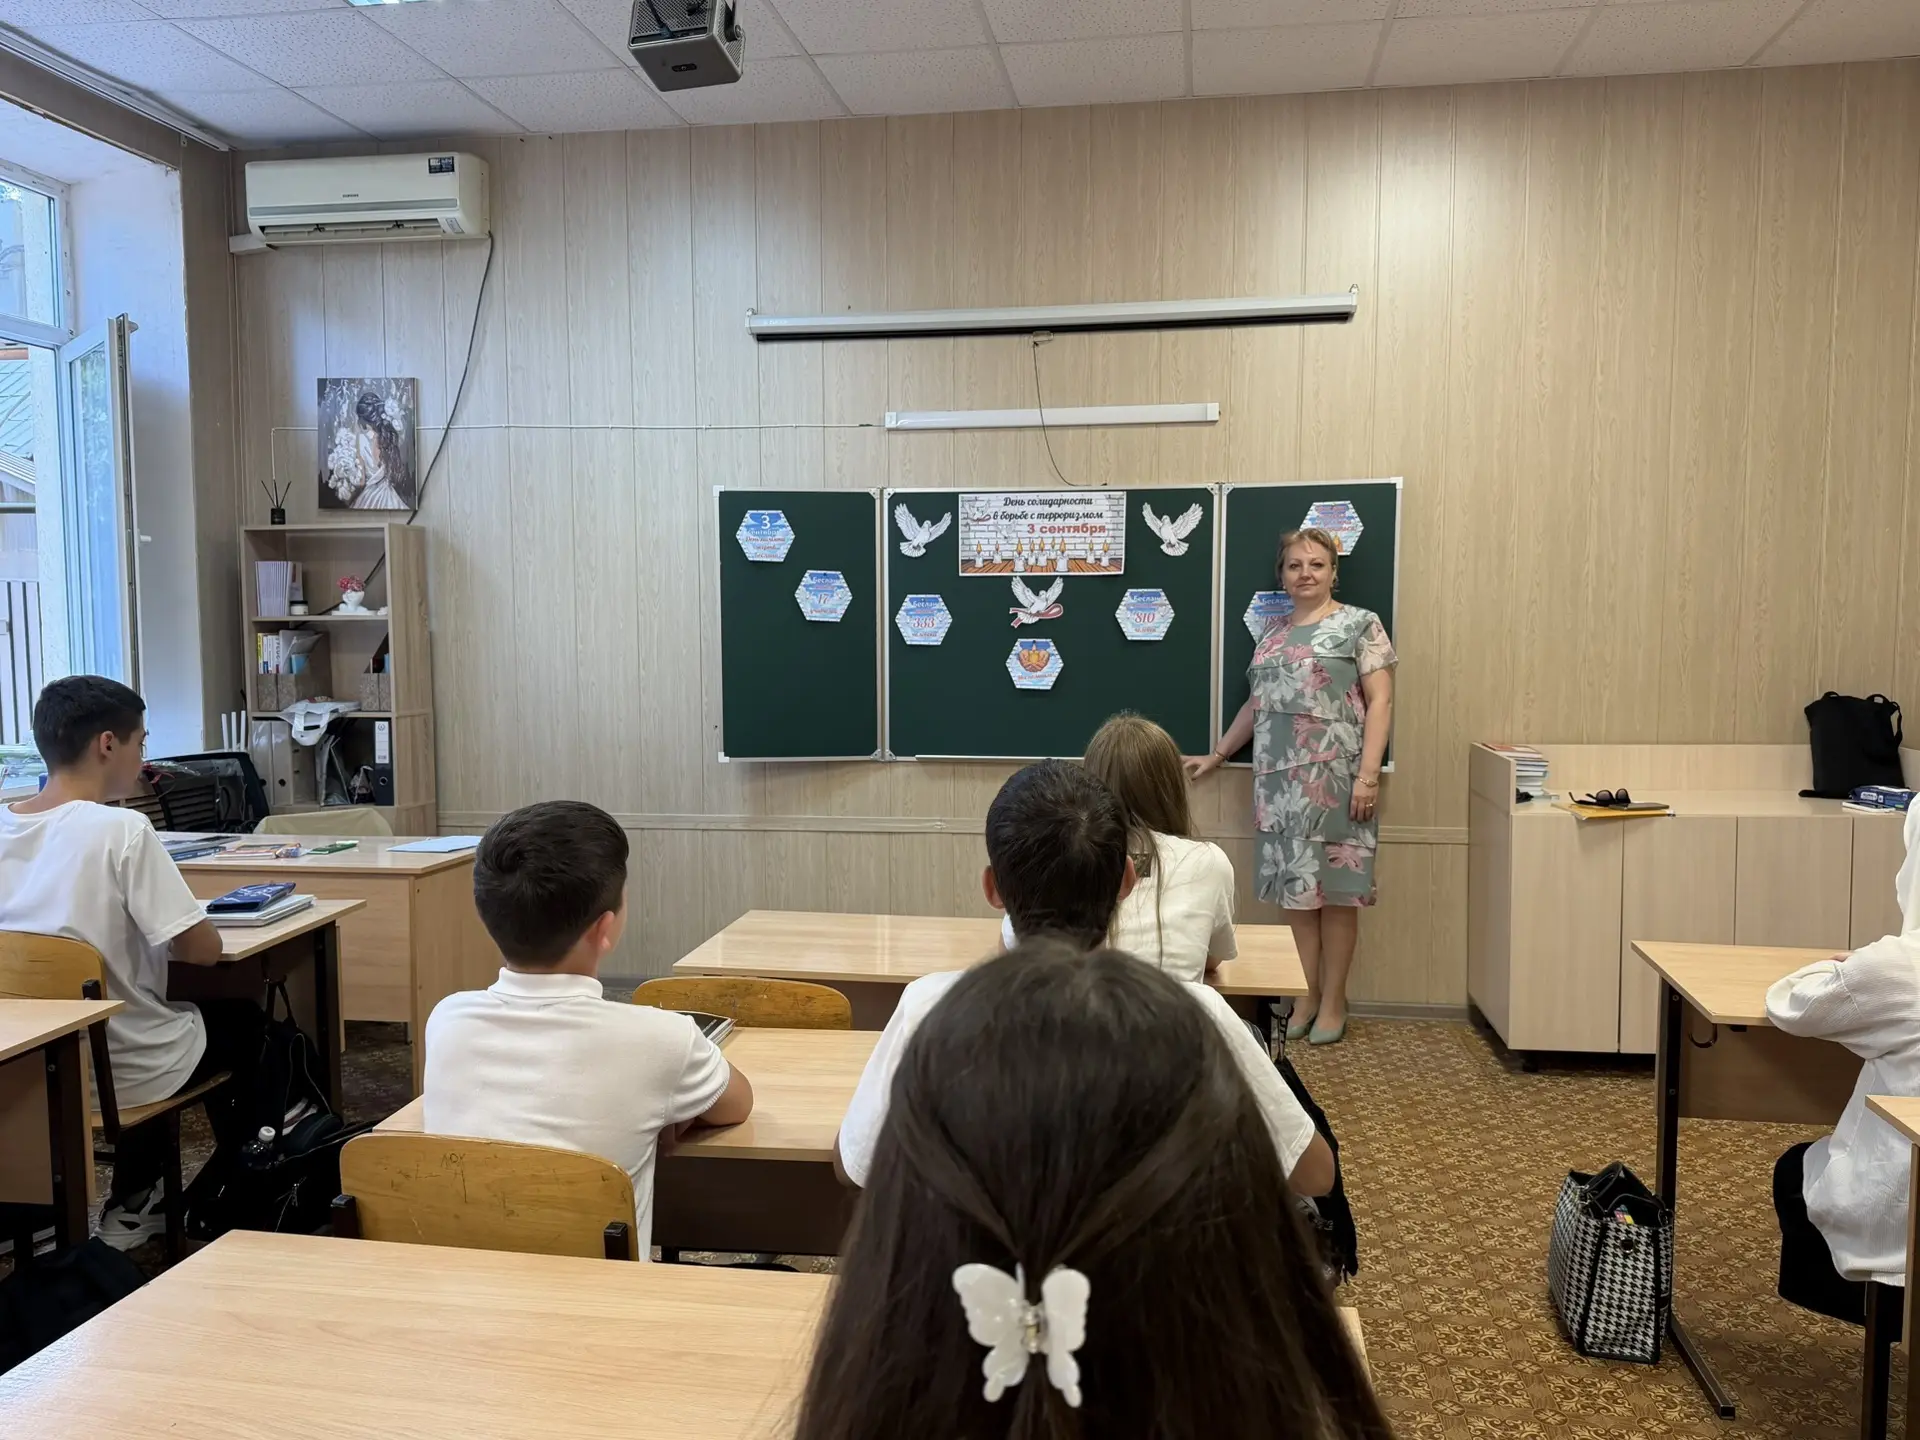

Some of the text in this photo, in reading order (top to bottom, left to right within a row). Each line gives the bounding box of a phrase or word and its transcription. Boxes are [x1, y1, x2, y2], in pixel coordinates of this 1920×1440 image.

[1003, 497, 1093, 508] День солидарности
[993, 511, 999, 520] в
[1000, 510, 1029, 521] борьбе
[1037, 512, 1103, 522] терроризмом
[761, 515, 771, 530] 3
[1027, 523, 1106, 536] 3 сентября
[1135, 612, 1155, 624] 810
